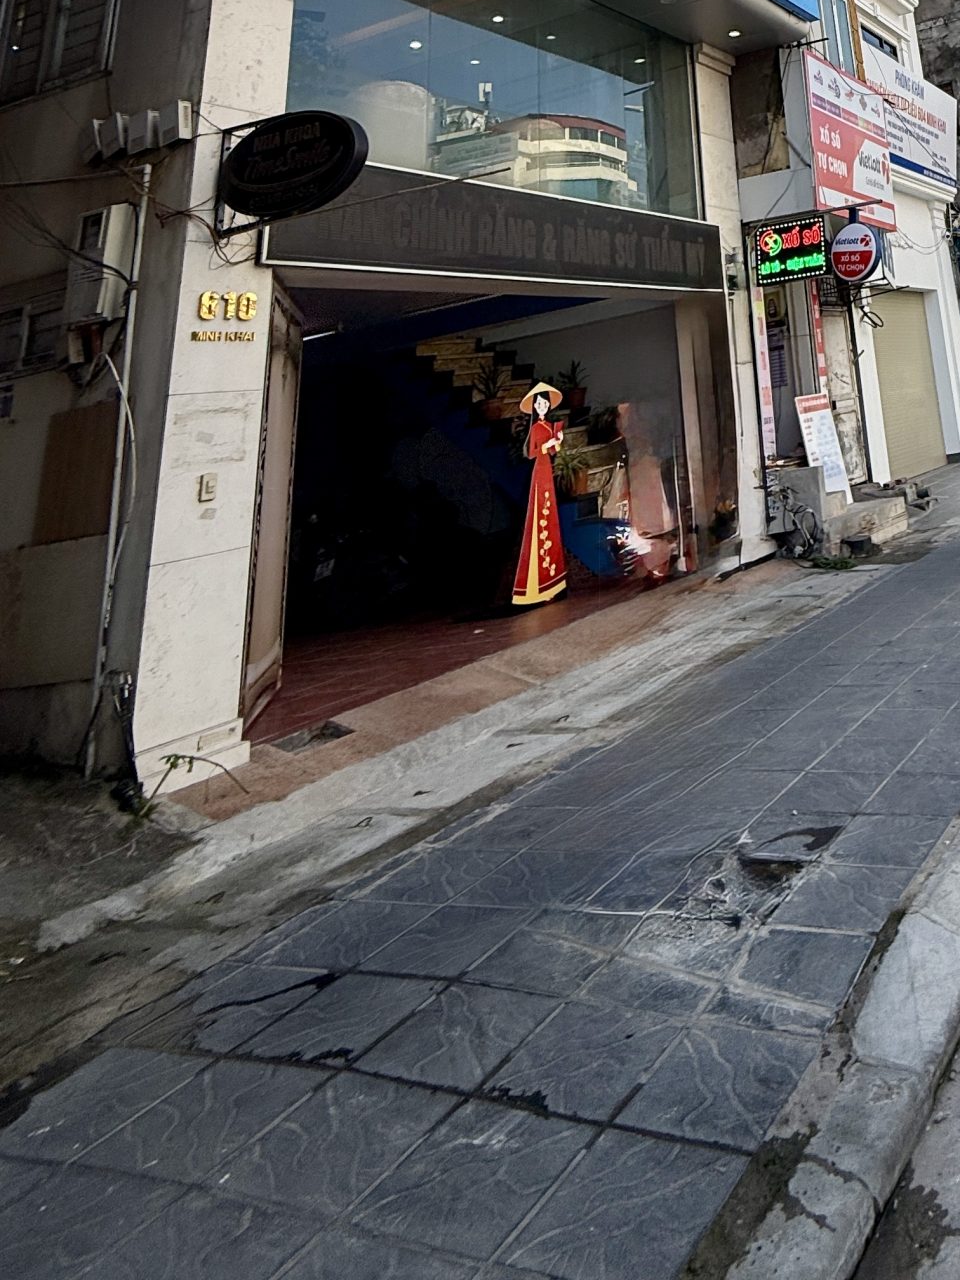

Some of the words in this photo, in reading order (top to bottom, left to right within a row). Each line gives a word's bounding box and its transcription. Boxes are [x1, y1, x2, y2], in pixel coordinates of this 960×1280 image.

[197, 291, 258, 321] 610
[190, 331, 221, 342] MINH
[224, 331, 256, 342] KHAI
